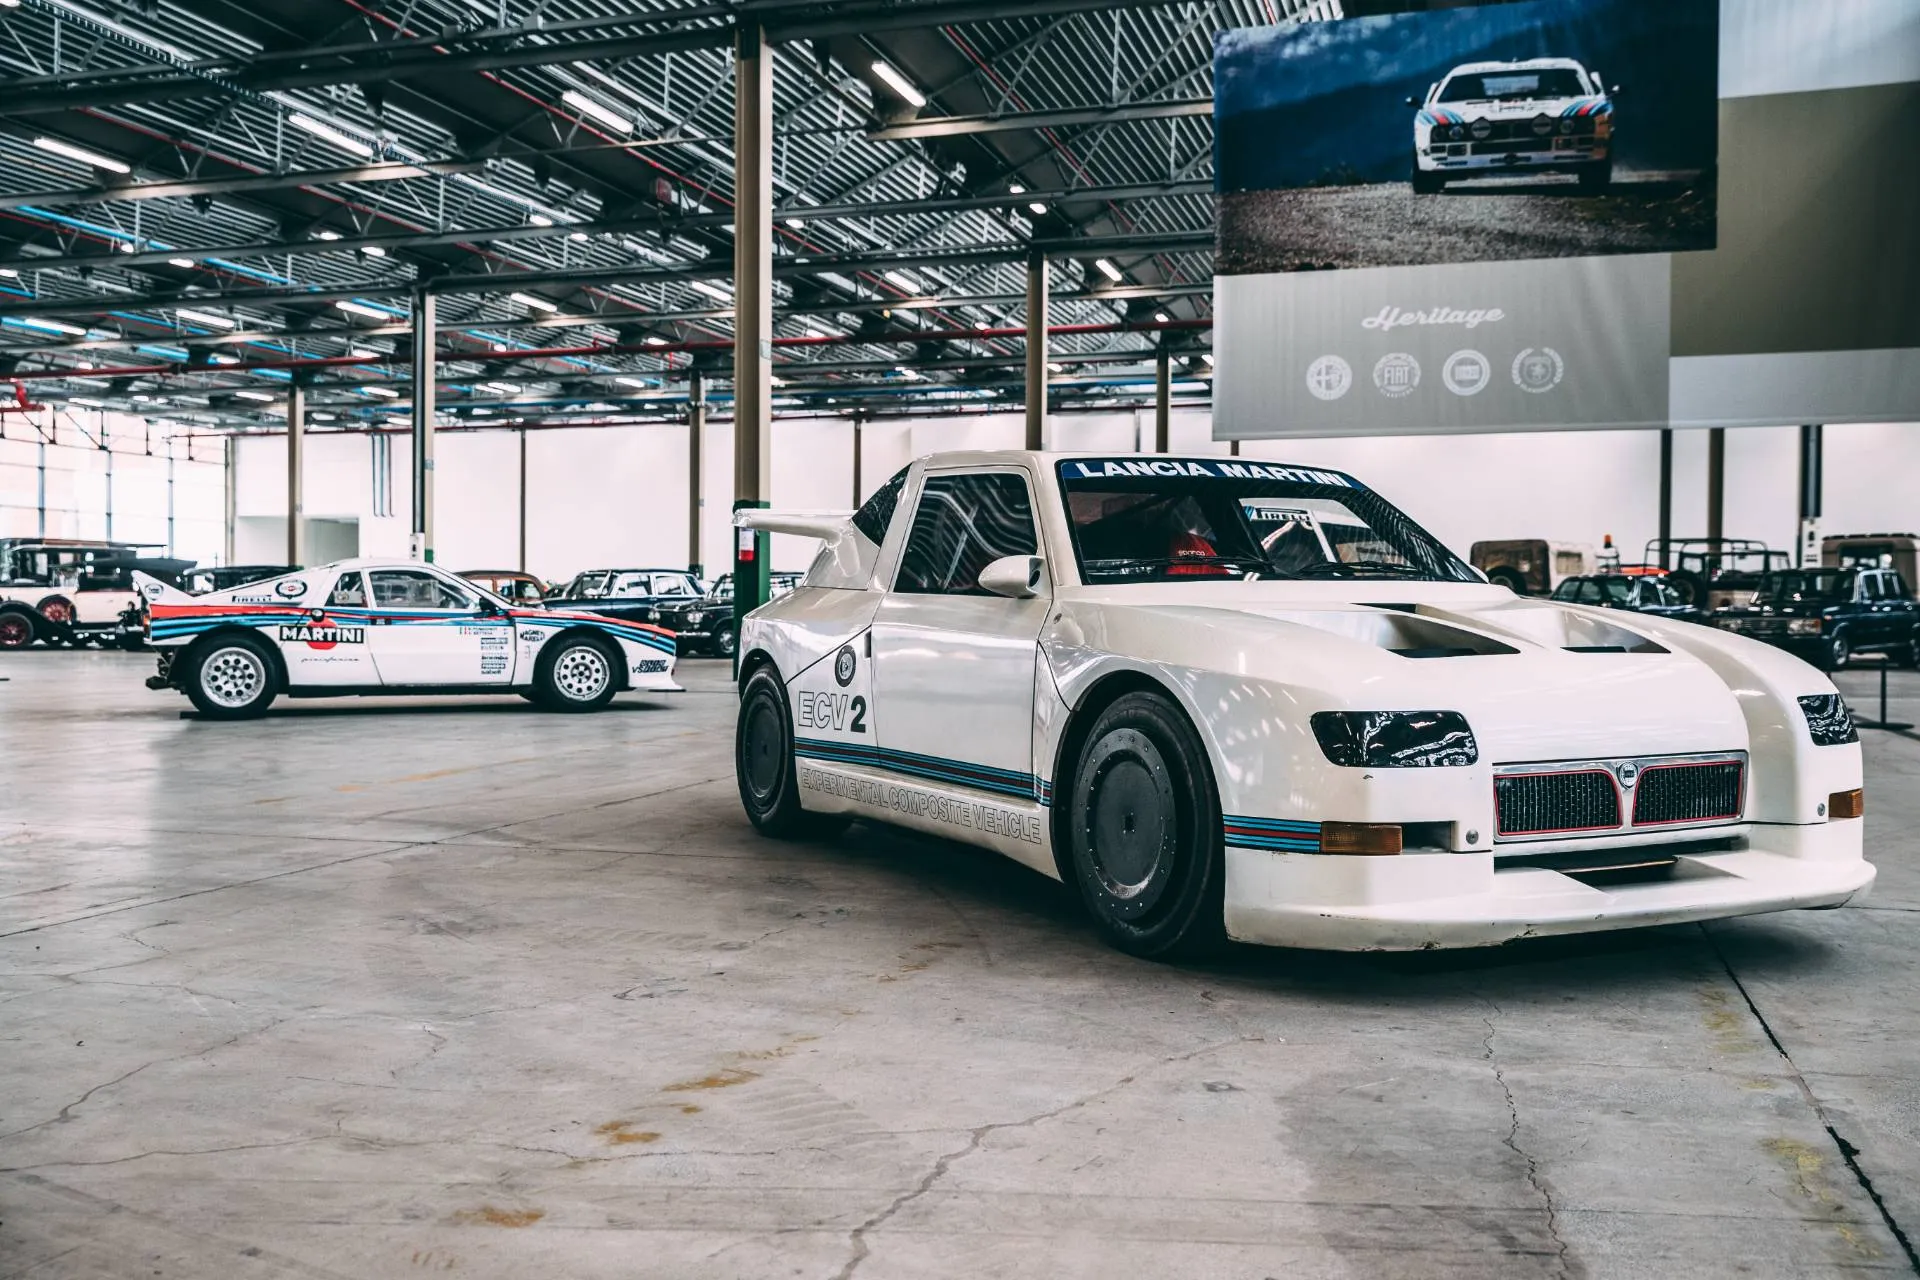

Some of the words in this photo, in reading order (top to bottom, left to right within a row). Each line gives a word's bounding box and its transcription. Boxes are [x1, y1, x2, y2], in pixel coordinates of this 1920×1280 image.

[1361, 305, 1505, 331] Heritage
[1384, 365, 1410, 385] FIAT
[1075, 462, 1215, 477] LANCIA
[1216, 463, 1353, 488] MARTINI
[1255, 508, 1311, 521] PIRELLI
[281, 627, 362, 642] MARTINI
[798, 691, 848, 730] ECV
[850, 695, 866, 733] 2
[801, 768, 889, 807] EXPERIMENTAL
[889, 786, 972, 828] COMPOSITE
[973, 804, 1042, 845] VEHICLE
